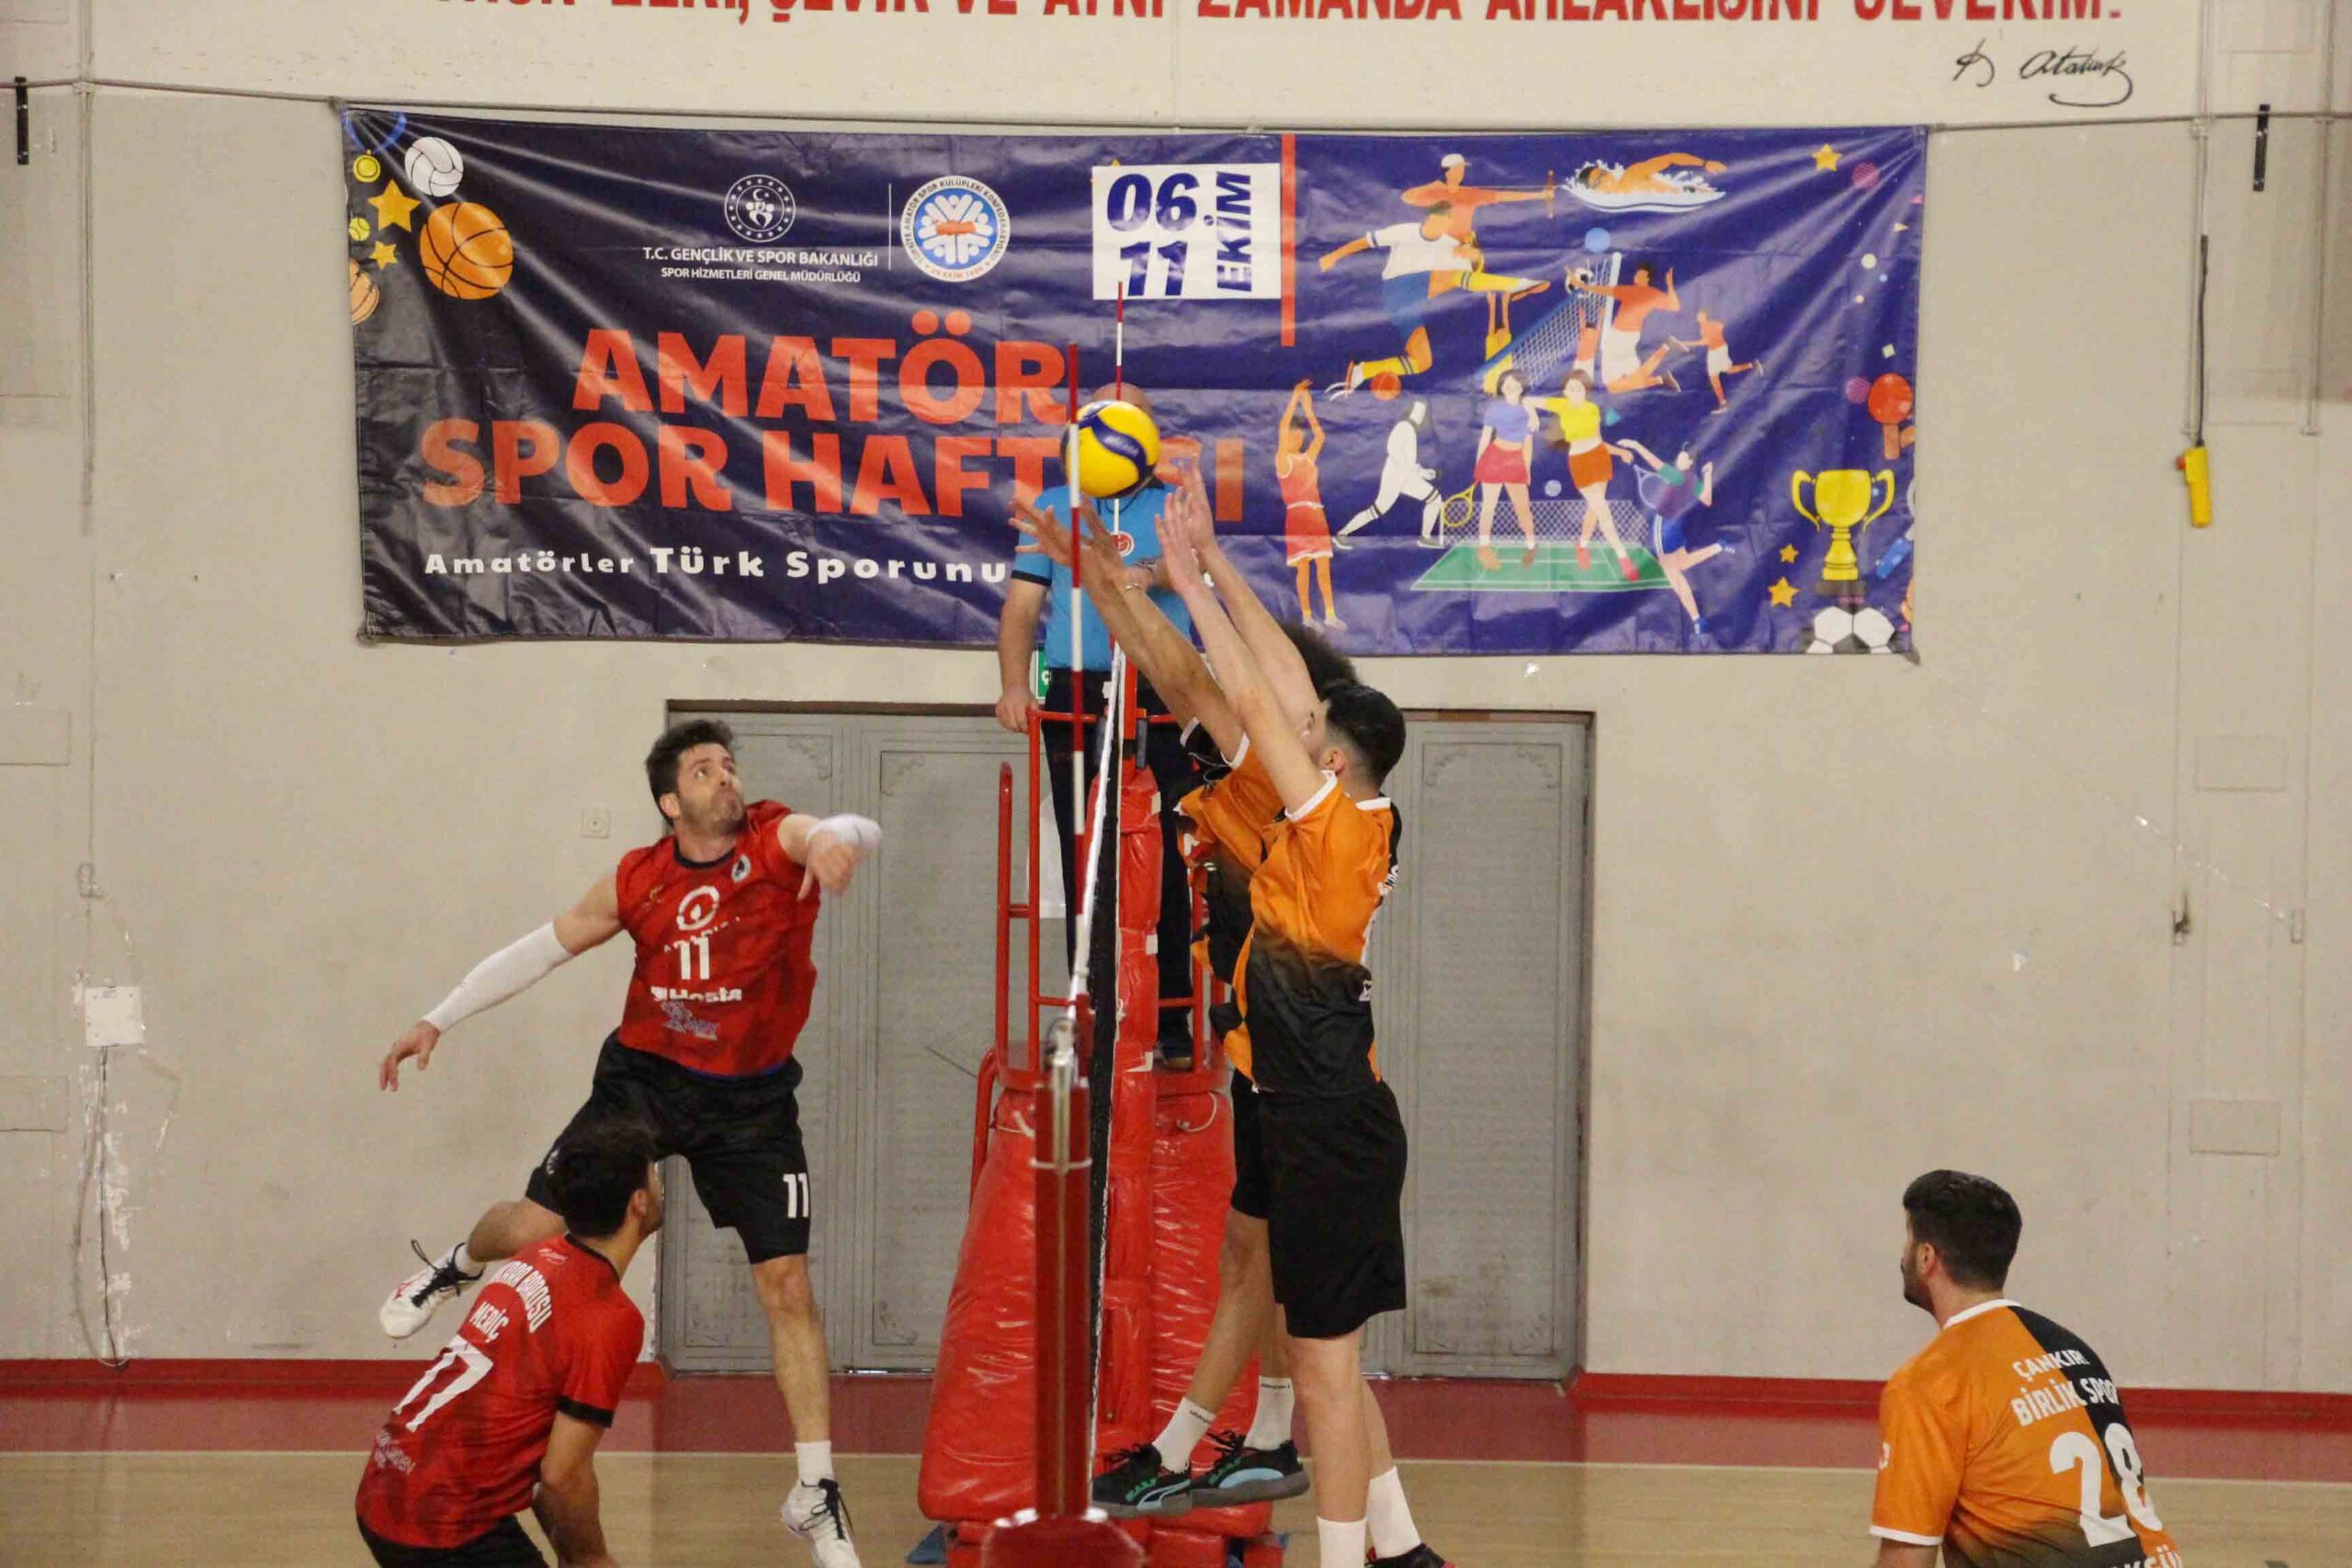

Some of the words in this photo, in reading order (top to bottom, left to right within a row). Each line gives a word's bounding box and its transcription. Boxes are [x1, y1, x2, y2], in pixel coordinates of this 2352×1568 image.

[1107, 173, 1200, 231] 06
[643, 247, 669, 260] T.C.
[671, 247, 733, 265] GENÇLİK
[735, 249, 754, 263] VE
[757, 251, 797, 265] SPOR
[798, 251, 878, 267] BAKANLIĞI
[1204, 171, 1252, 292] EKİM
[661, 266, 689, 278] SPOR
[691, 265, 753, 280] HİZMETLERİ
[754, 270, 789, 281] GENEL
[790, 270, 861, 283] MÜDÜRLÜĞÜ
[1120, 241, 1188, 296] 11
[572, 310, 1068, 424] AMATÖR
[421, 418, 732, 512] SPOR
[424, 550, 636, 574] Amatörler
[650, 547, 764, 577] Türk
[673, 935, 710, 980] 11
[783, 1172, 808, 1219] 11
[393, 1334, 493, 1432] 17
[2011, 1378, 2087, 1427] BİRLİK
[2049, 1423, 2163, 1548] 28
